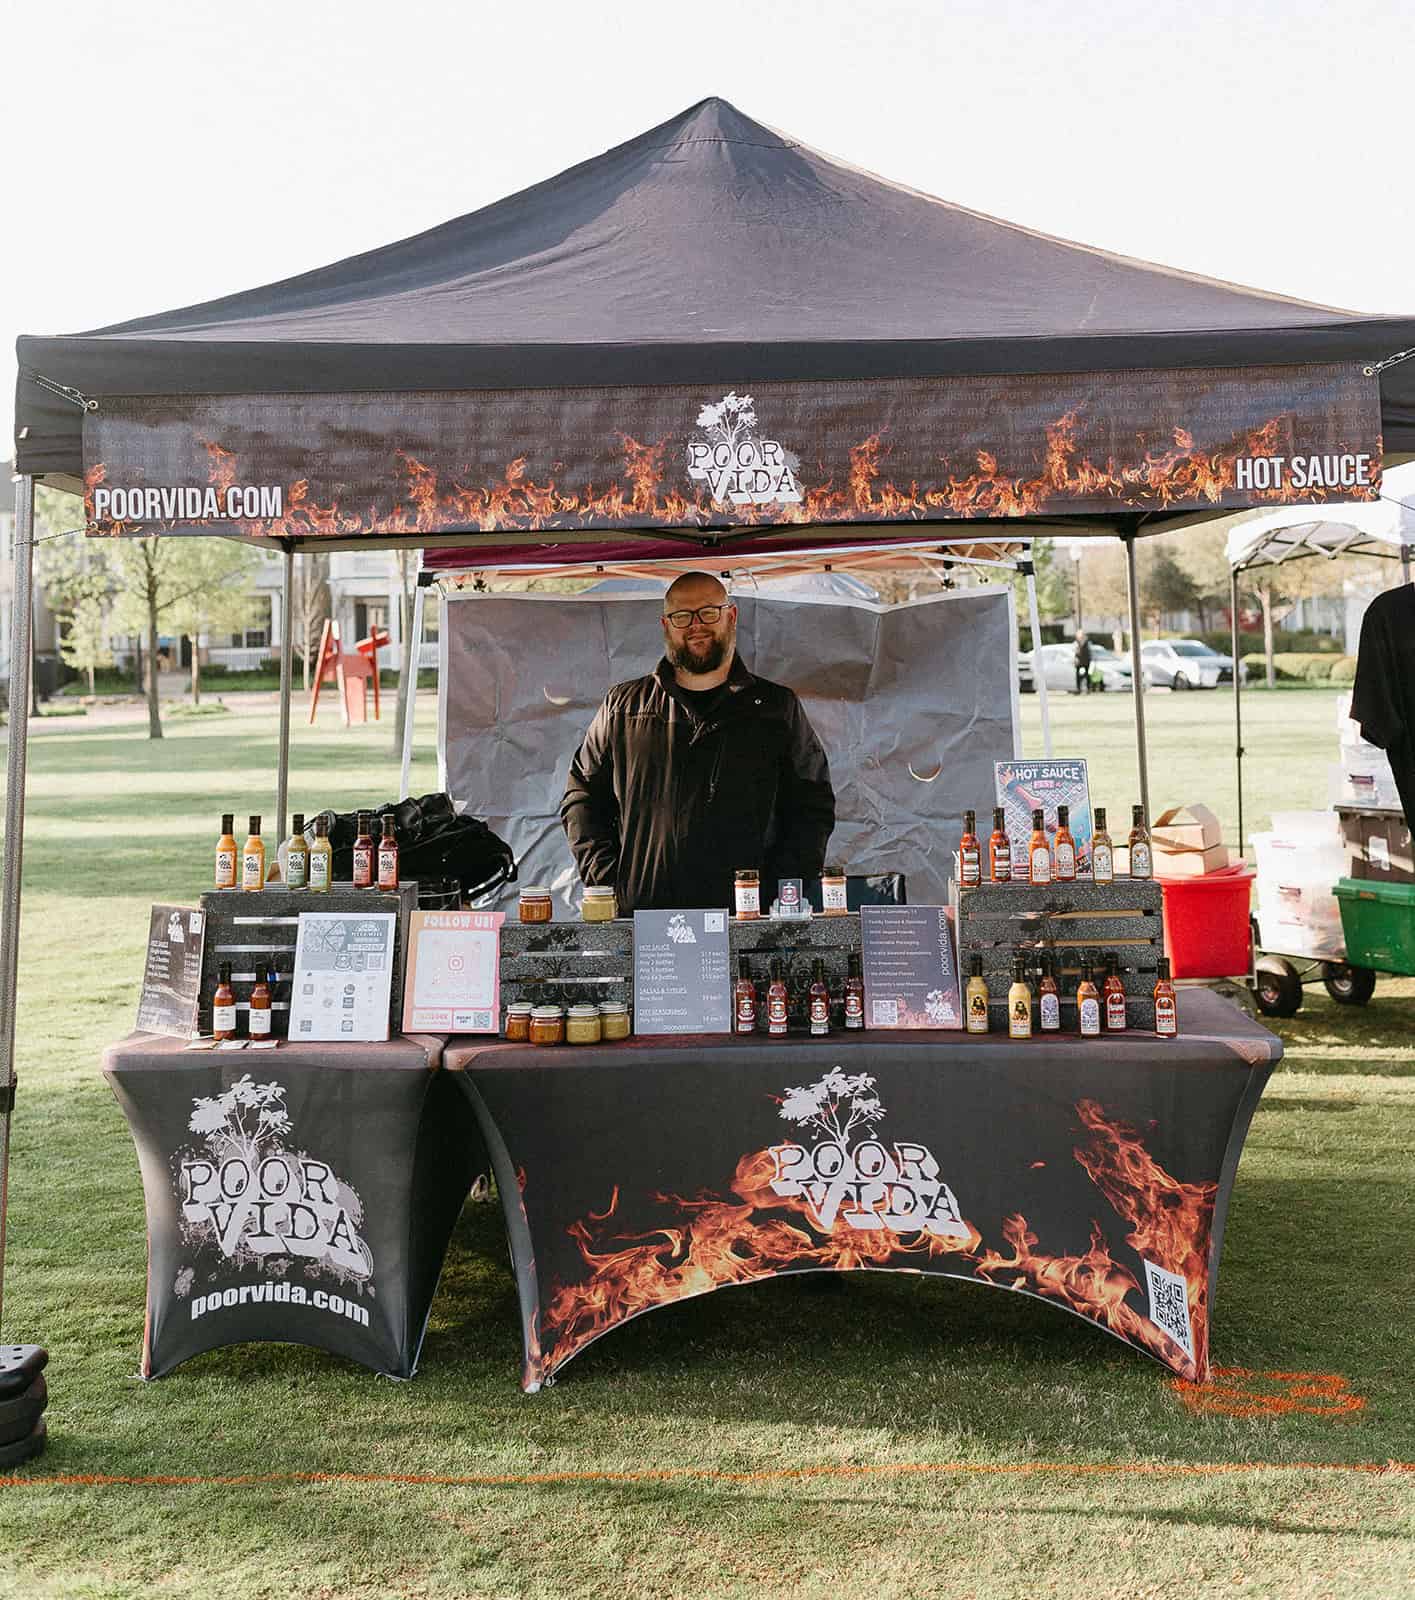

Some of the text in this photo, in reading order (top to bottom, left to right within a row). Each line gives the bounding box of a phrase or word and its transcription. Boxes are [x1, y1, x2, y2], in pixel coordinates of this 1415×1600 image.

[689, 441, 783, 469] POOR
[1236, 454, 1370, 490] HOT SAUCE
[94, 485, 282, 520] POORVIDA.COM
[704, 467, 800, 501] VIDA
[1015, 767, 1080, 781] HOT SAUCE
[424, 914, 471, 928] FOLLOW
[937, 909, 951, 976] poorvida.com
[182, 1156, 337, 1207] POOR
[768, 1141, 940, 1183] POOR
[799, 1179, 967, 1232] VIDA
[207, 1200, 366, 1260] VIDA
[190, 1280, 370, 1327] poorvida.com
